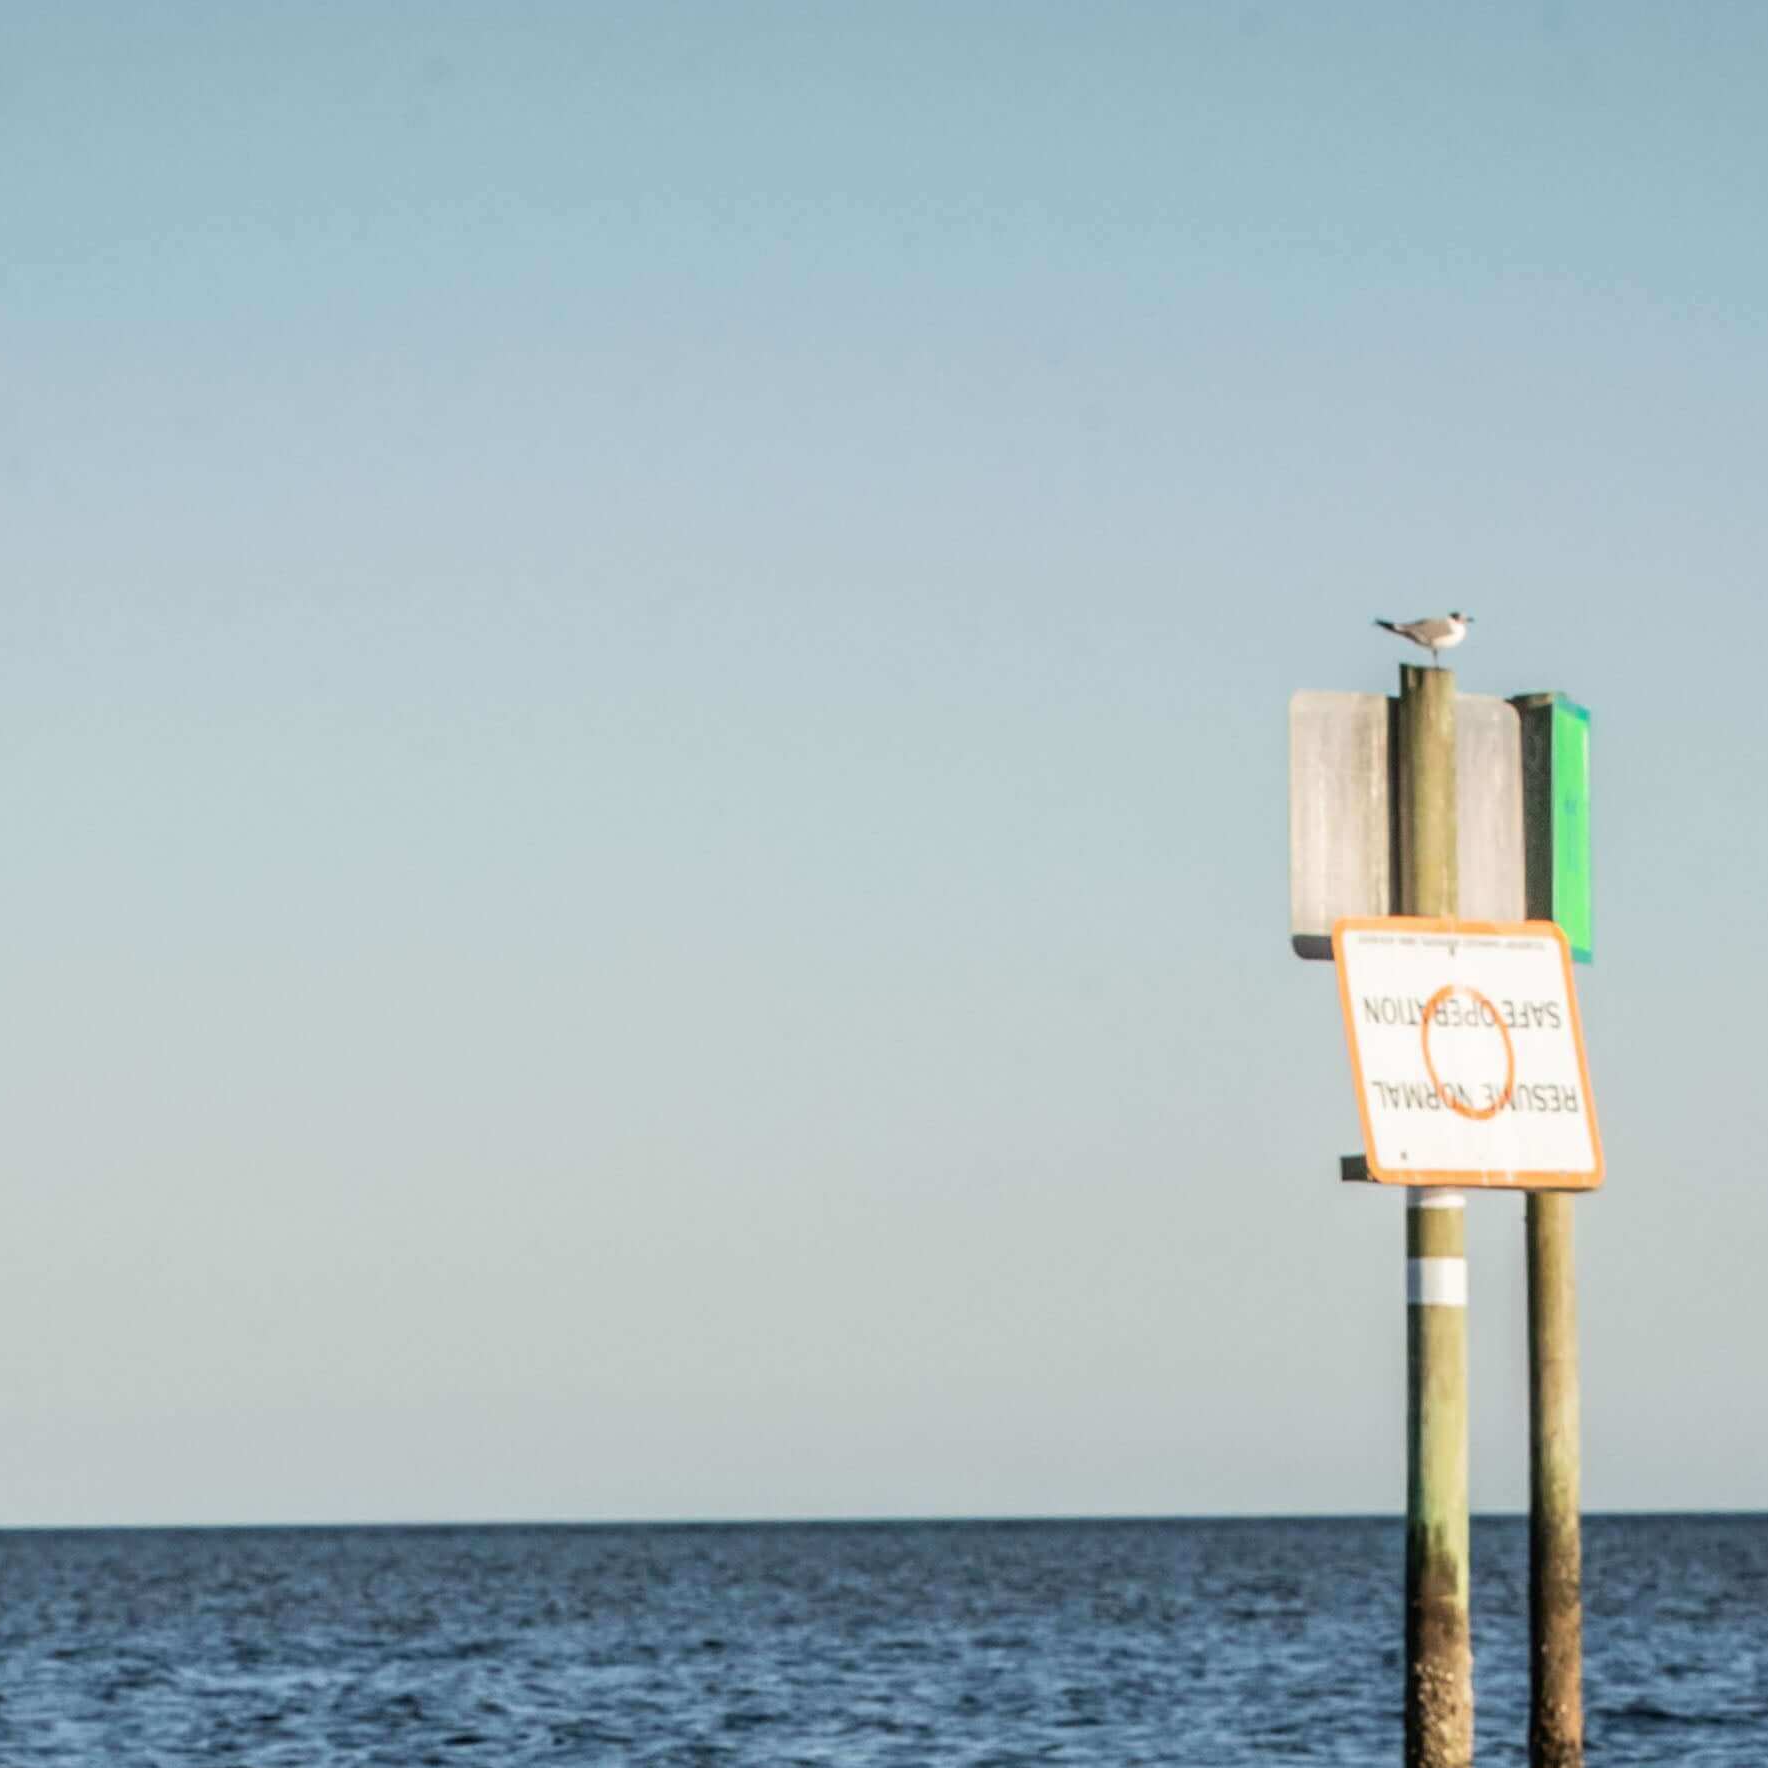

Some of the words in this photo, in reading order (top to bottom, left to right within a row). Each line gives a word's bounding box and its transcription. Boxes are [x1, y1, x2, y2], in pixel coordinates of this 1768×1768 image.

[1363, 996, 1498, 1027] OPERATION
[1501, 999, 1562, 1029] SAFE
[1371, 1080, 1475, 1111] NORMAL
[1479, 1082, 1579, 1113] RESUME
